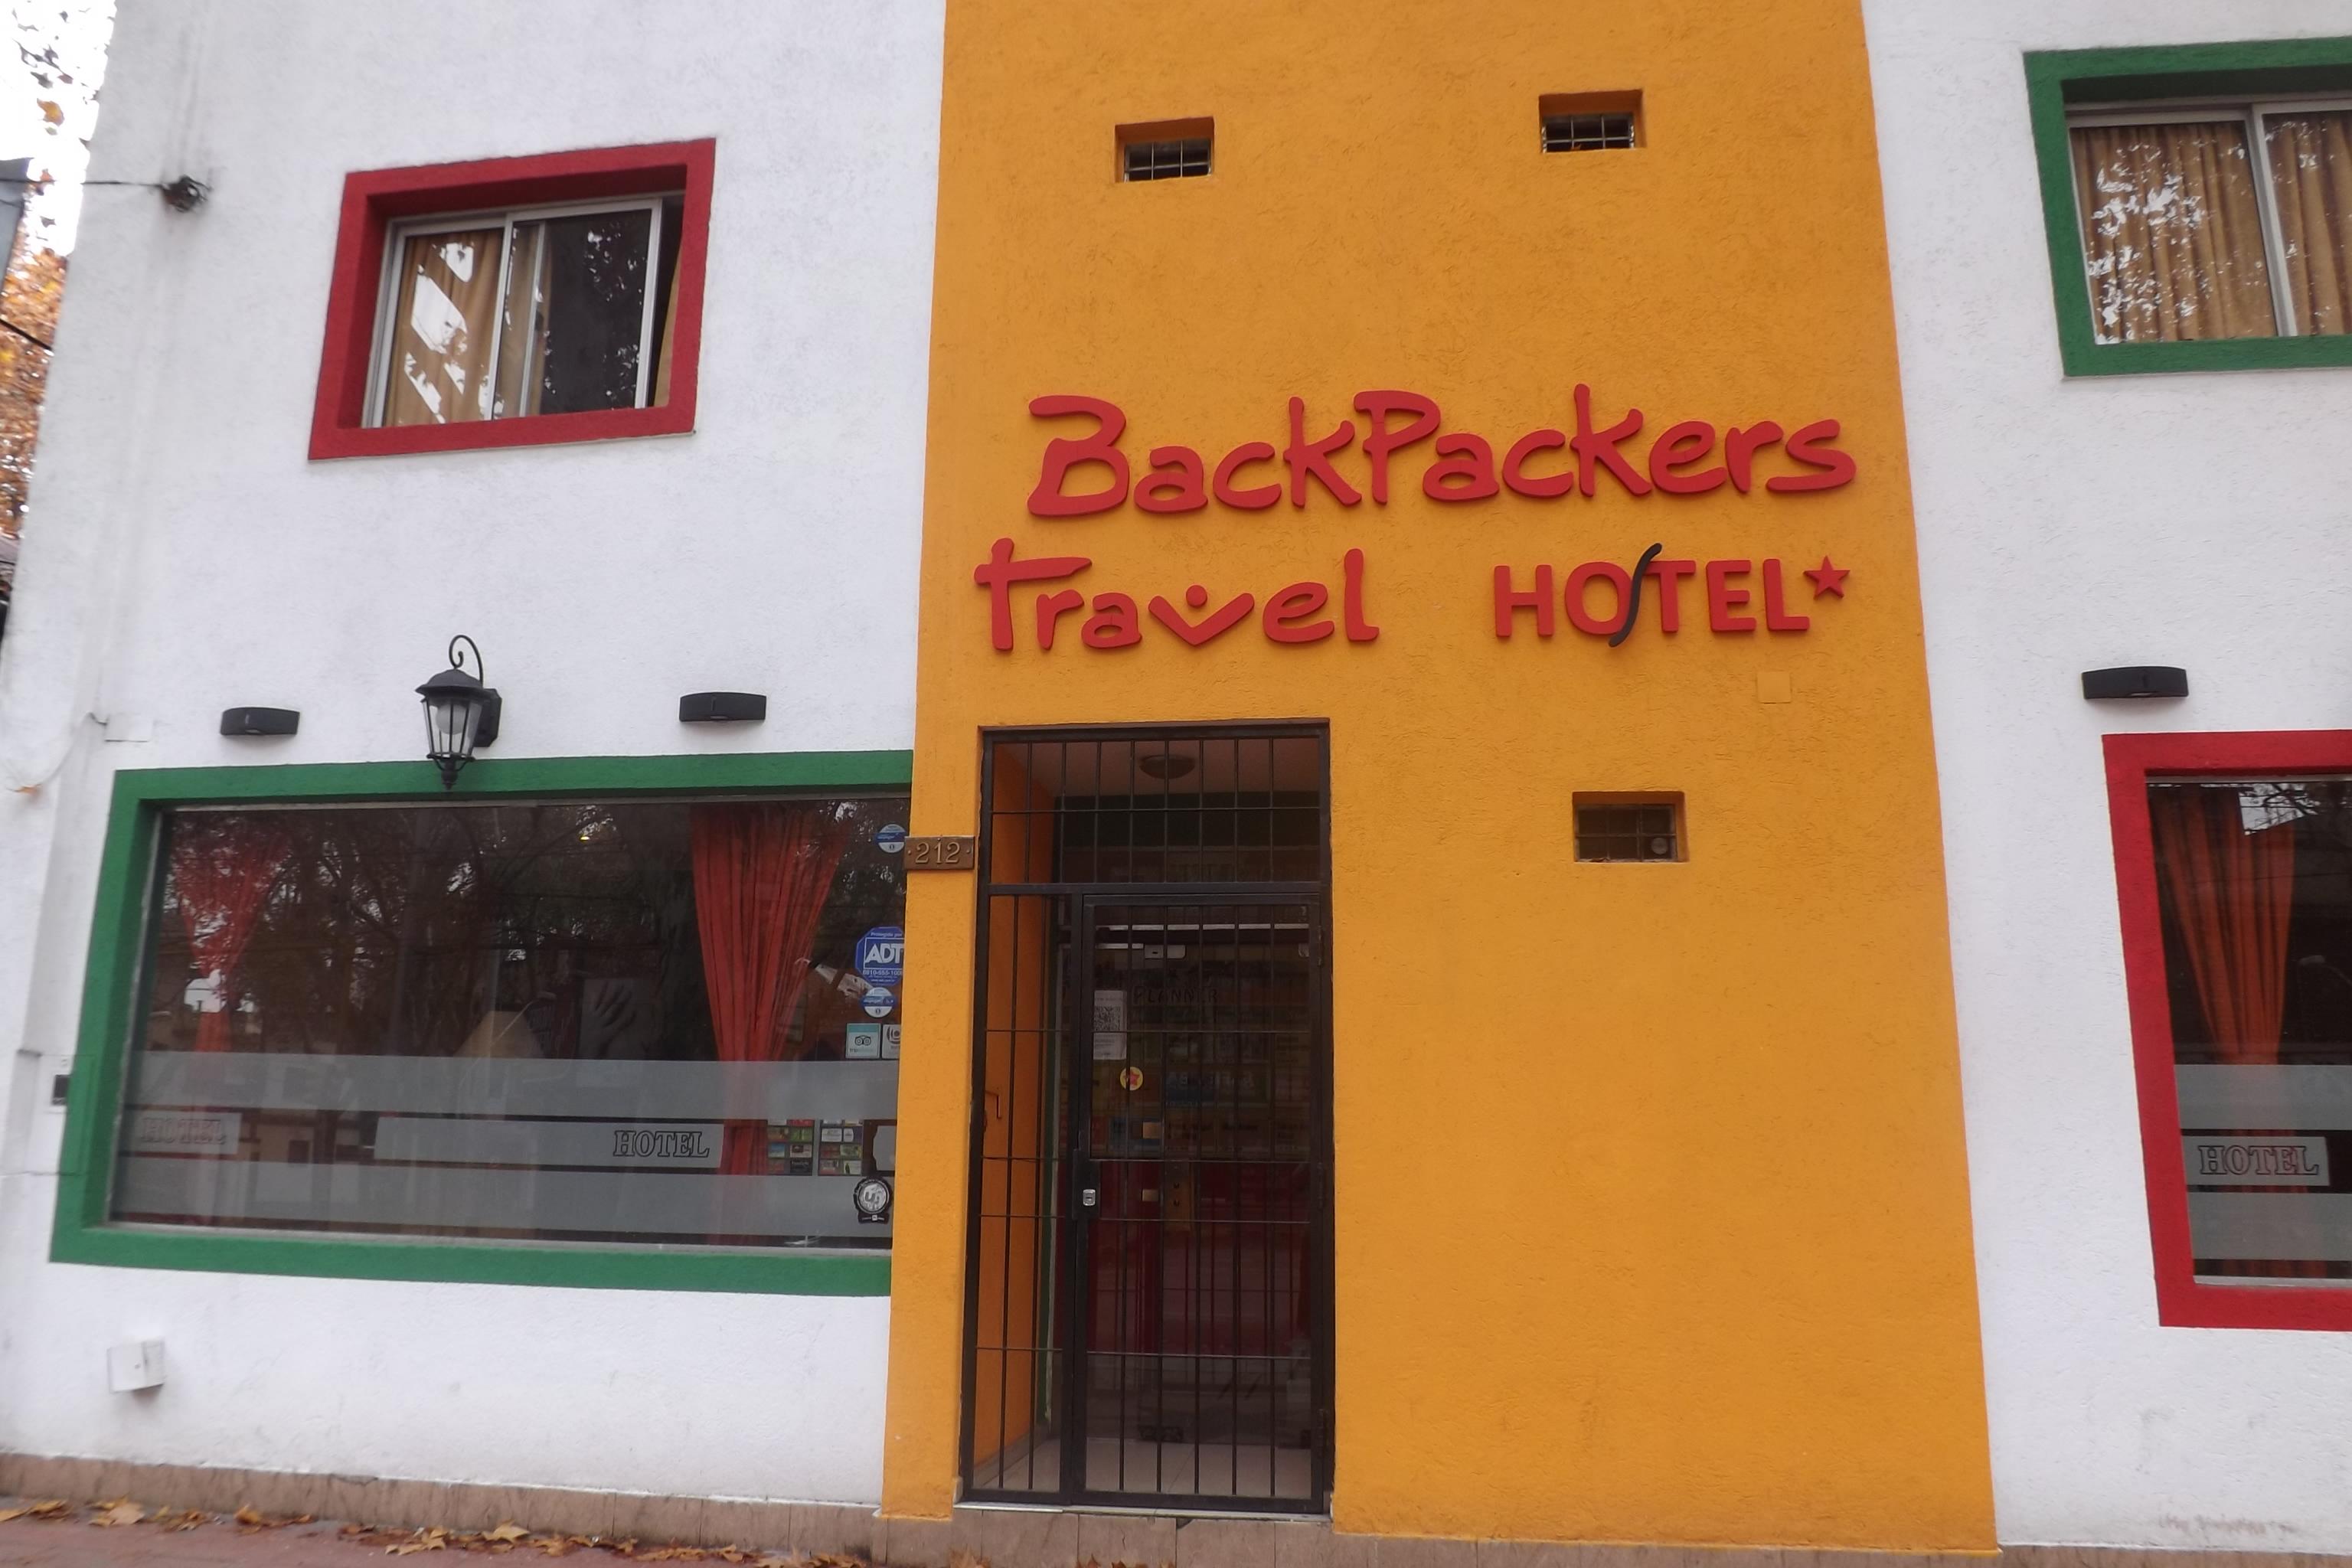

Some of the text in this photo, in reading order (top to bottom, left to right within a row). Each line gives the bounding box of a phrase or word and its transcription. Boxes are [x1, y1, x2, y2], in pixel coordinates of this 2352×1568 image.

[1028, 384, 1856, 517] BackPackers
[1495, 543, 1810, 648] HOSTEL
[915, 841, 960, 864] 212
[865, 943, 904, 963] ADT
[613, 1130, 710, 1158] HOTEL
[2198, 1145, 2319, 1175] HOTEL
